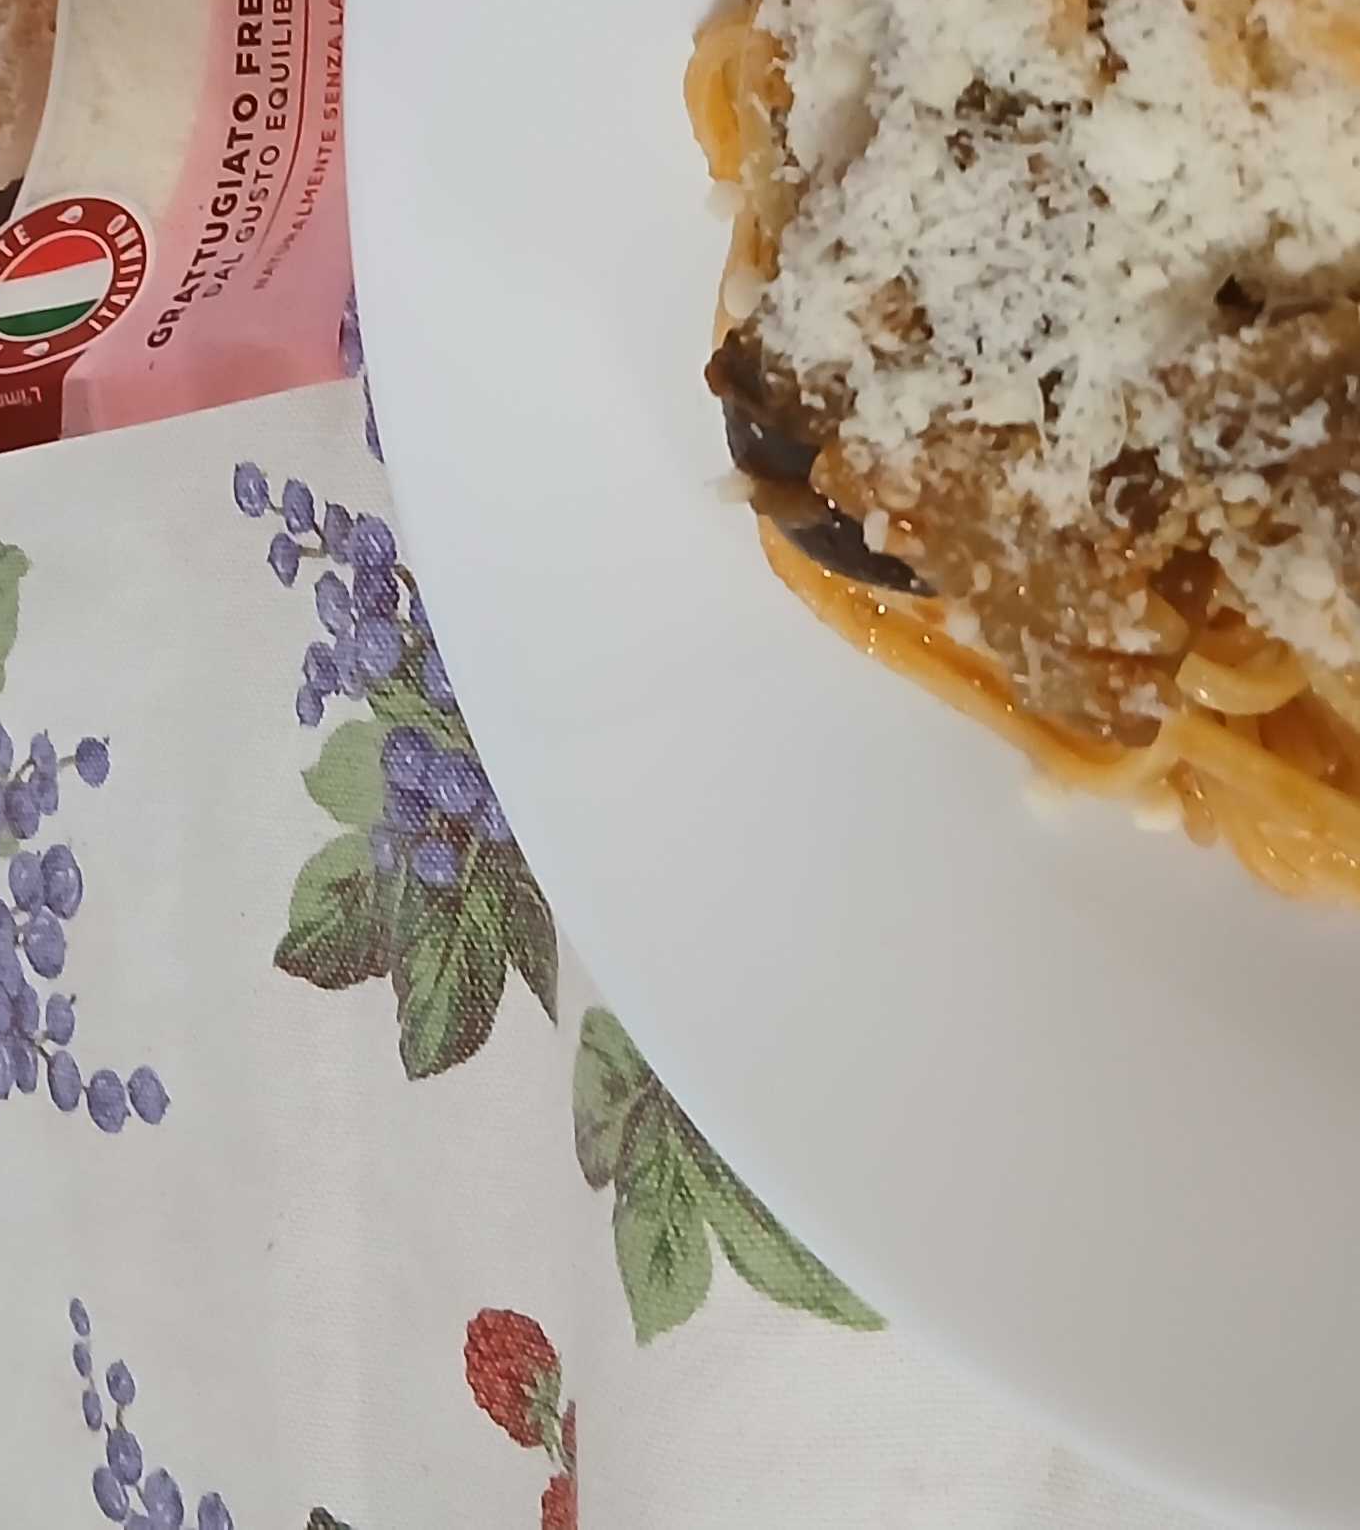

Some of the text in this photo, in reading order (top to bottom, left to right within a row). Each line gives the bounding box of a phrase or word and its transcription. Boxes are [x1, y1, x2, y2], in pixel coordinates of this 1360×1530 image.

[147, 94, 259, 349] GRATTUGIATO
[202, 253, 244, 298] DAL
[236, 145, 280, 242] GUSTO
[252, 130, 336, 291] NATURALMENTE
[323, 37, 343, 121] SENZA
[88, 214, 142, 332] ITALIANO
